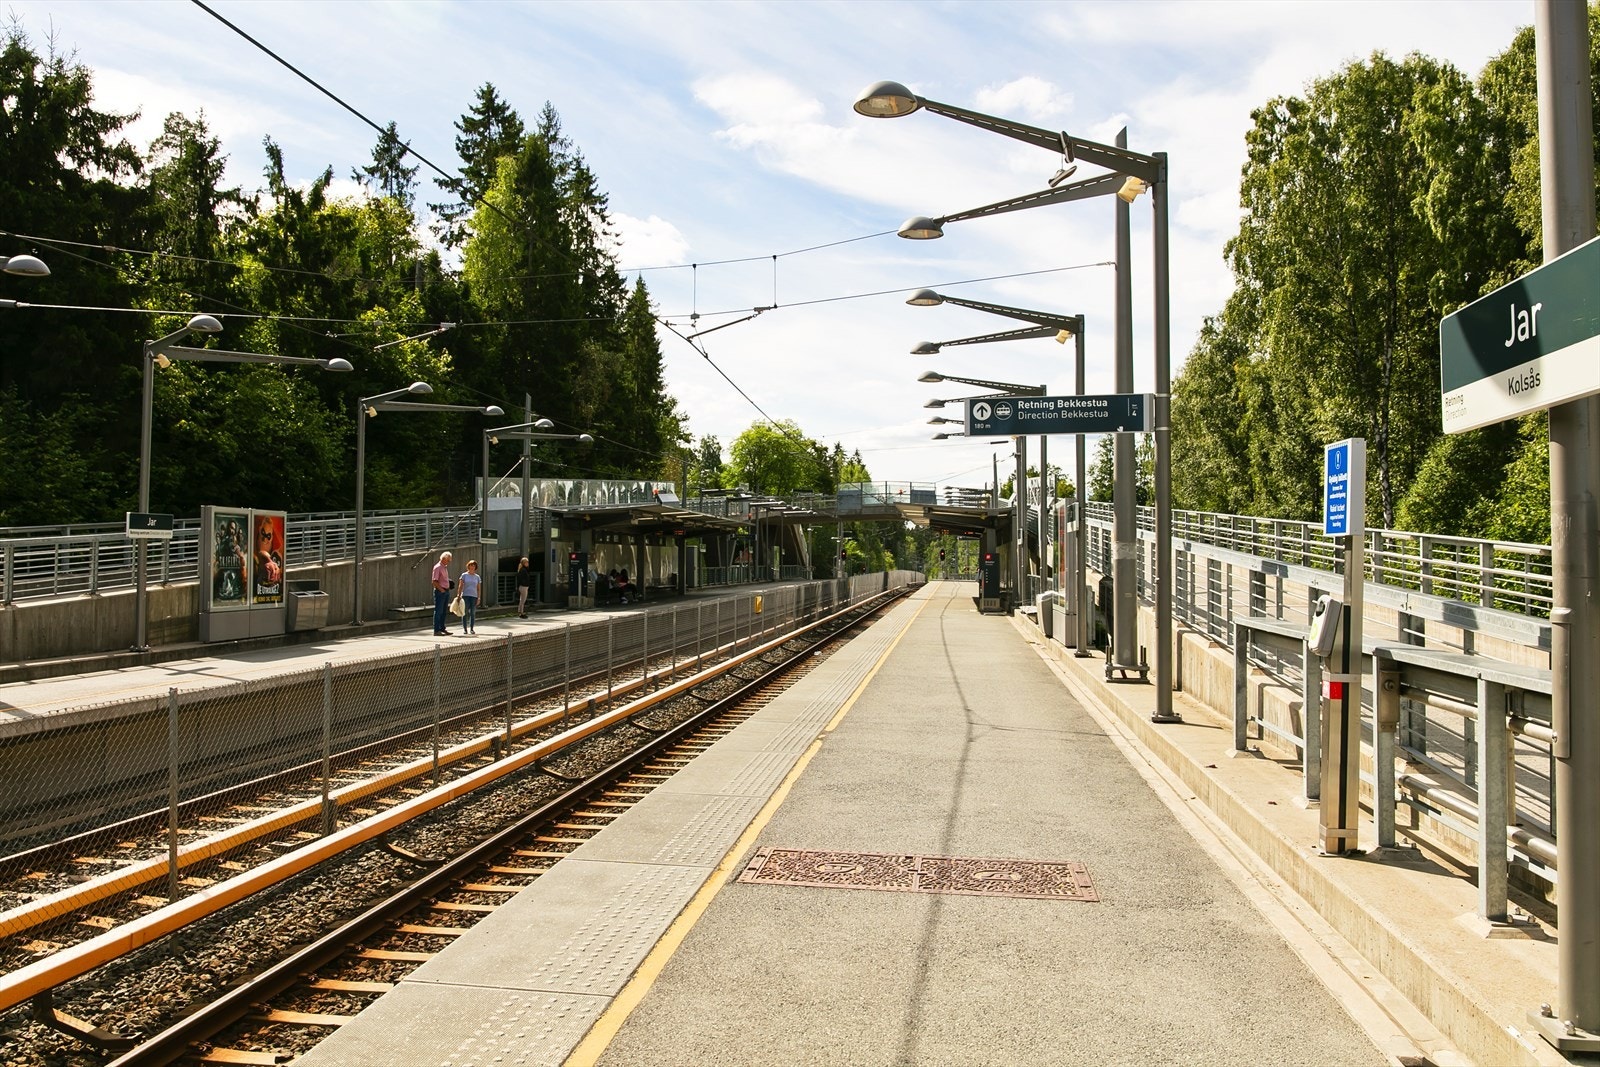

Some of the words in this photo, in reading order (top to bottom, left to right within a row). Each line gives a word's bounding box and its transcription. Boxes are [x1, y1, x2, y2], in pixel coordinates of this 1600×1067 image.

[1504, 302, 1543, 348] Jar
[1508, 367, 1541, 396] Kolsås
[1018, 400, 1055, 411] Retning
[1057, 399, 1108, 408] Bekkestua
[1018, 410, 1059, 420] Direction
[1061, 410, 1109, 418] Bekkestua
[147, 517, 157, 527] Jar
